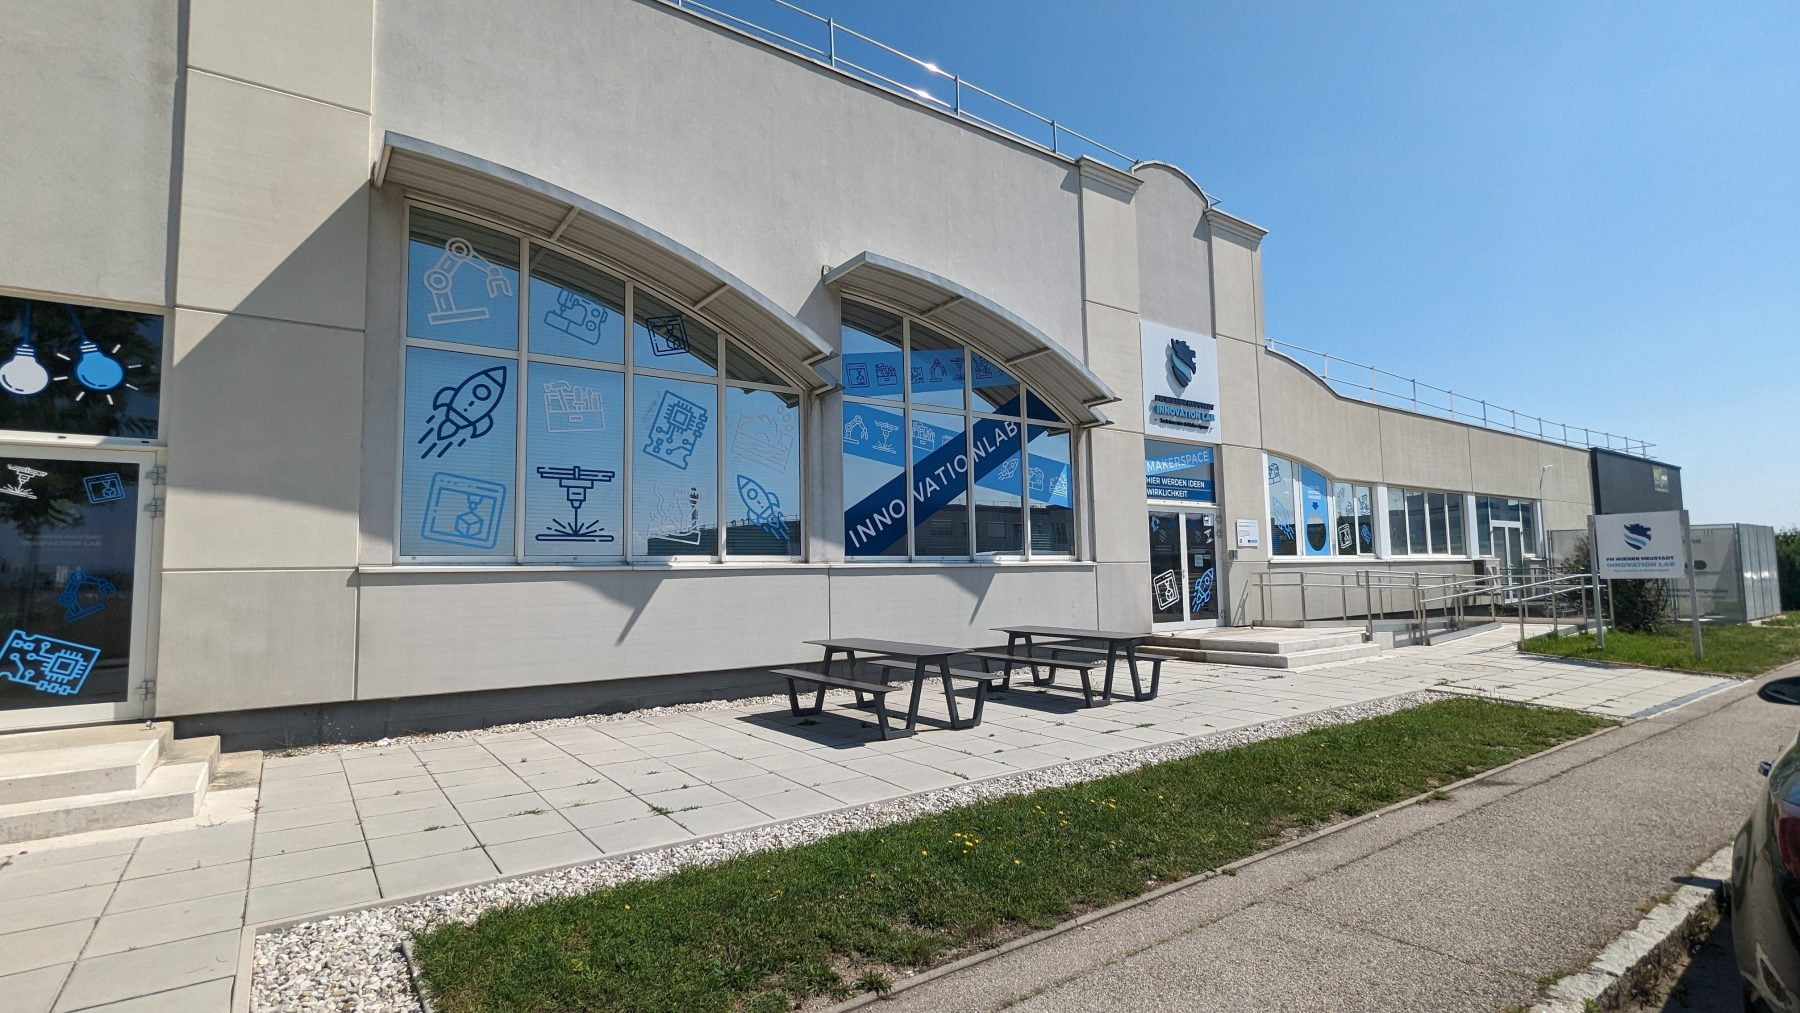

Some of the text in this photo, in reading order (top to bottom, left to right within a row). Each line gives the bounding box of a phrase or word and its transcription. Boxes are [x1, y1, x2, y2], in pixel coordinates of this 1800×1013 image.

[1156, 404, 1201, 420] INNOVATION
[1146, 451, 1209, 473] MAKERSPACE
[1146, 476, 1205, 488] HIER WERDEN IDEEN
[1146, 488, 1188, 498] WIRKLICHKEIT
